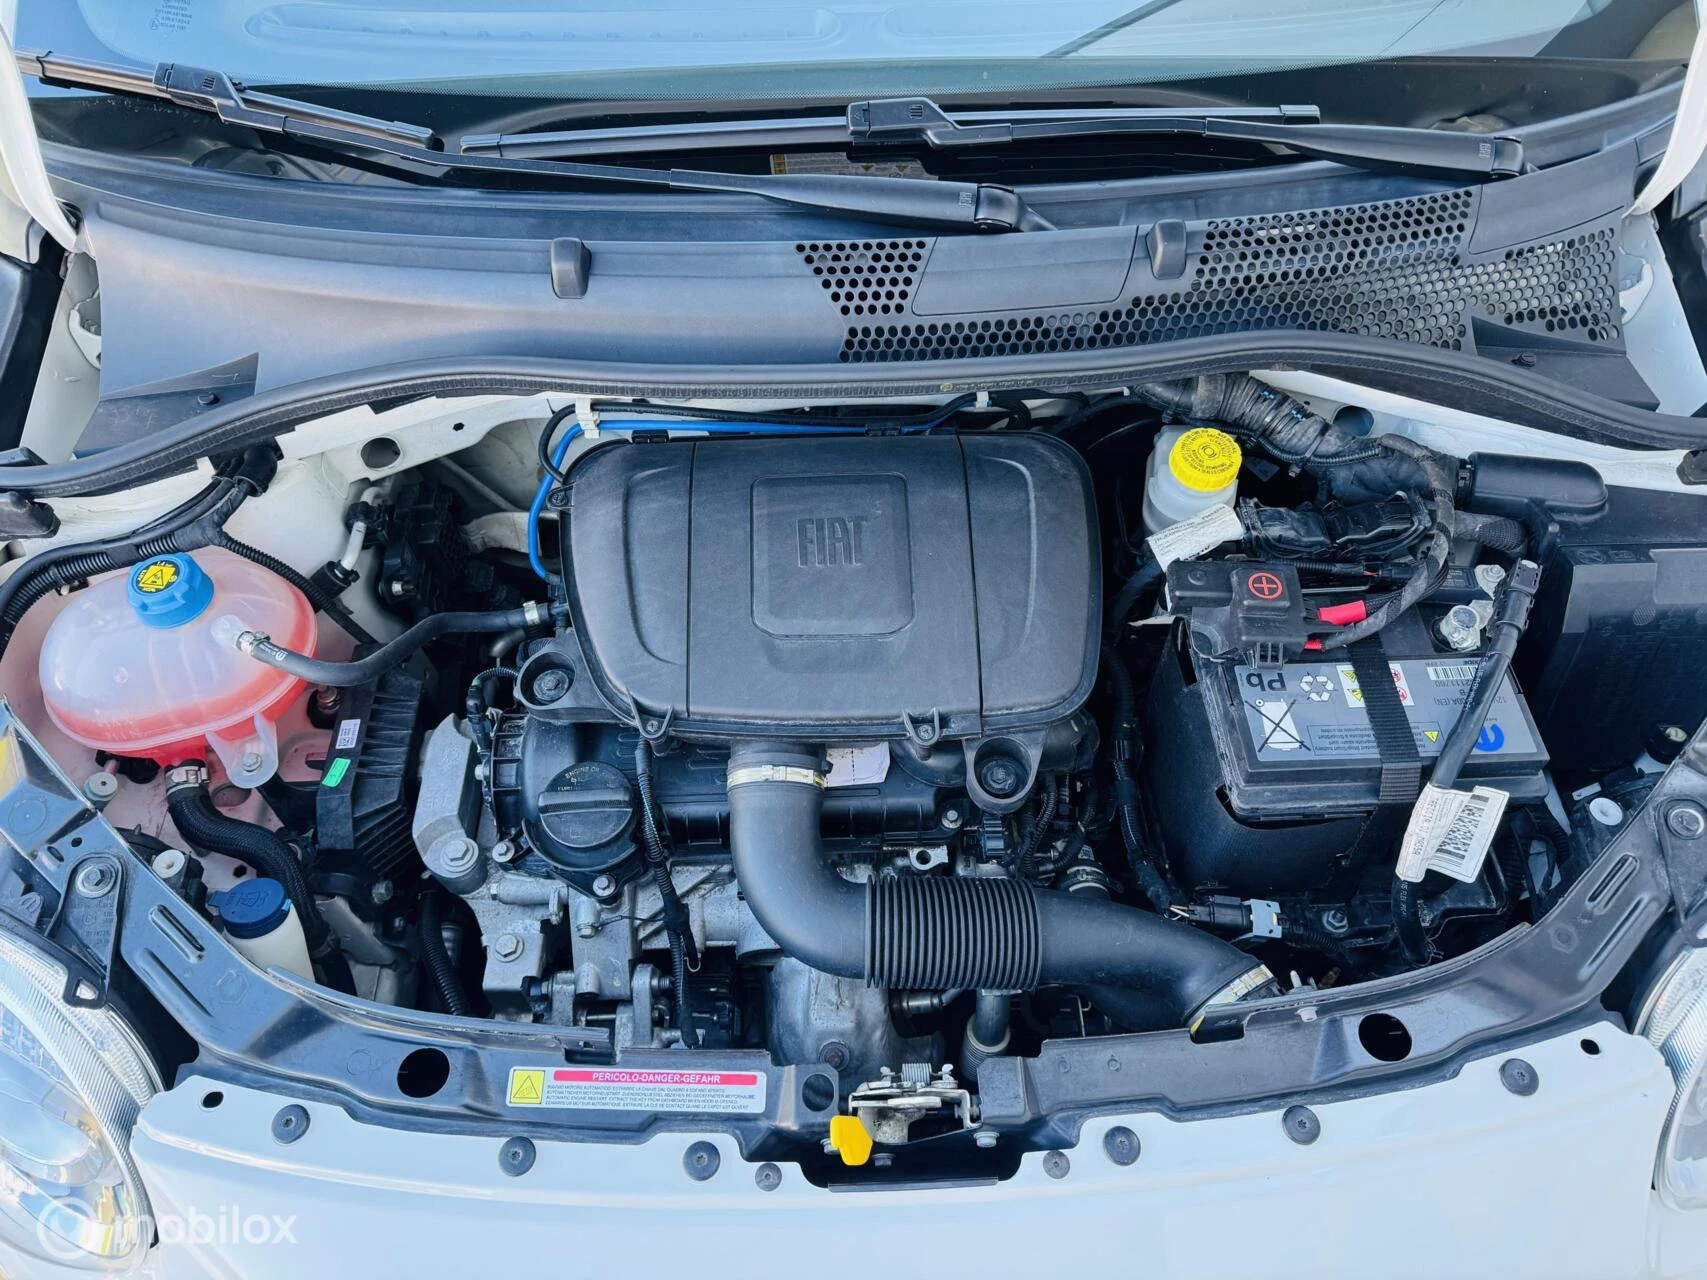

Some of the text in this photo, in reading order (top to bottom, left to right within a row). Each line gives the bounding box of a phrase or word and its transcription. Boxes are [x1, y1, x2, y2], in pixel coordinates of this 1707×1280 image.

[796, 516, 868, 567] FIAT
[1246, 672, 1287, 692] Pb
[592, 1072, 721, 1083] PERICOLO-DANGER-GEFAHR
